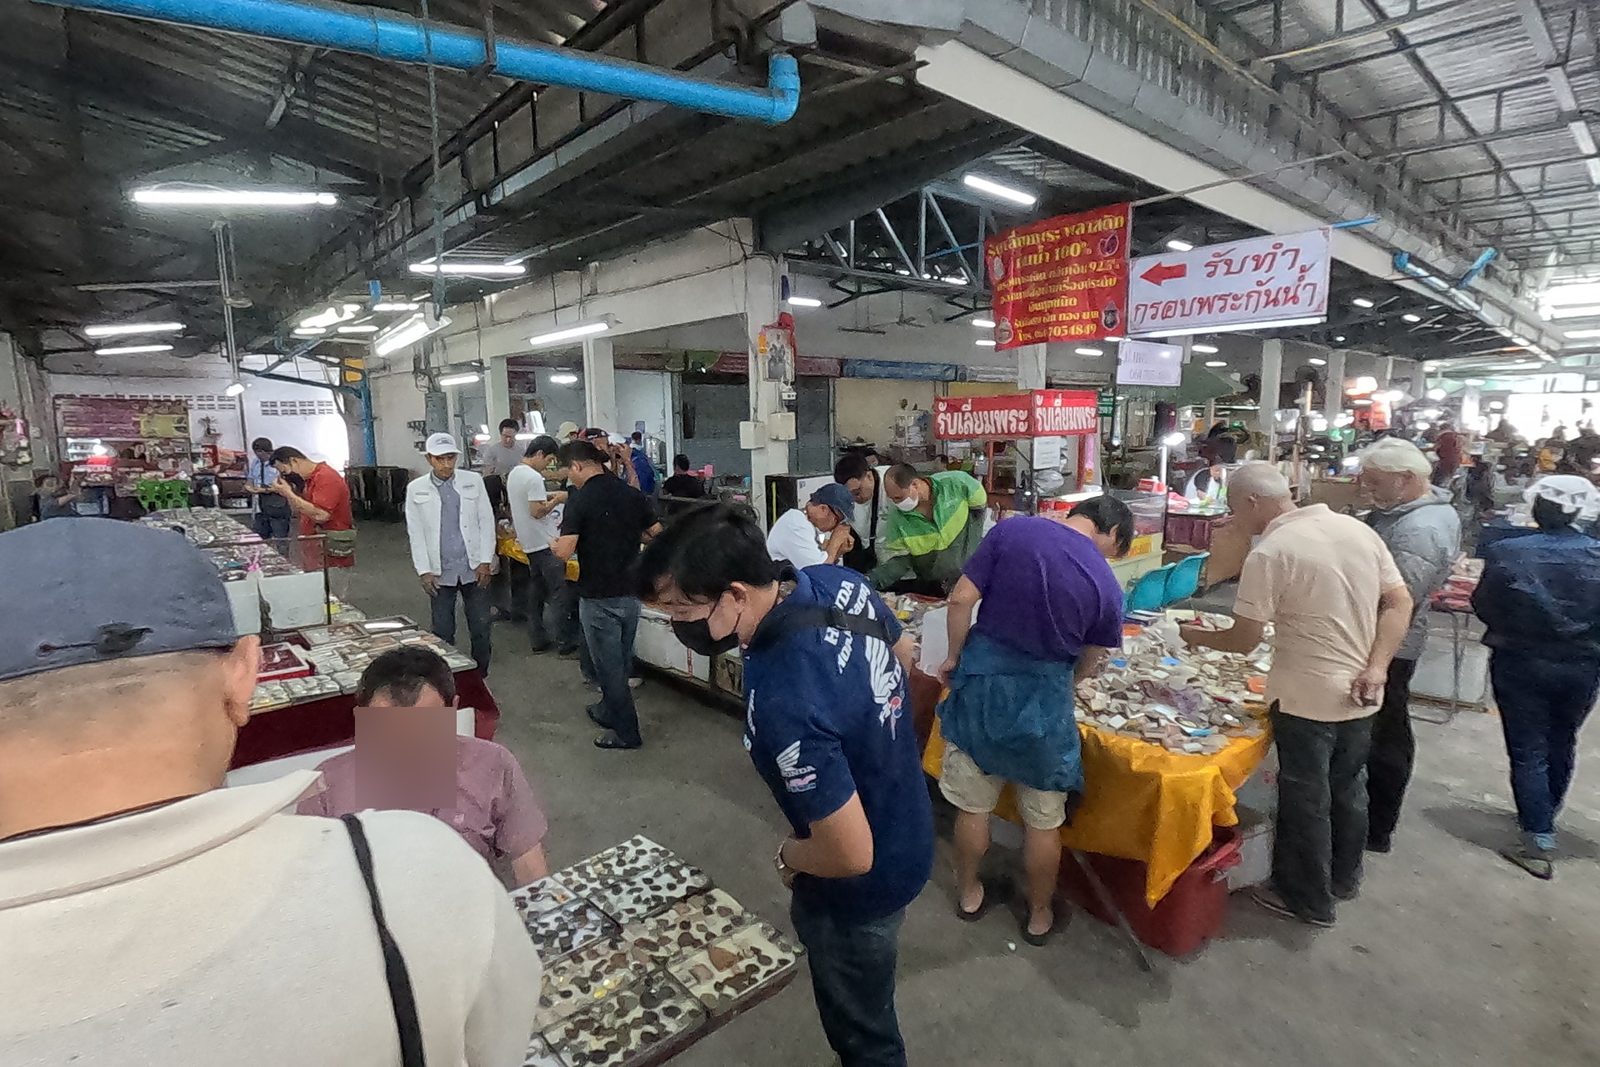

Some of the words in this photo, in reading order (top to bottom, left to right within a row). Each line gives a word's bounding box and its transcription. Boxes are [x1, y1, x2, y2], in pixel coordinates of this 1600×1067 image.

[1204, 242, 1301, 278] รับทำ
[1133, 262, 1318, 325] กรอบพระกันน้ำ
[937, 399, 1029, 435] รับเลี่ยมพระ
[1035, 392, 1097, 432] รับเลี่ยมพระ
